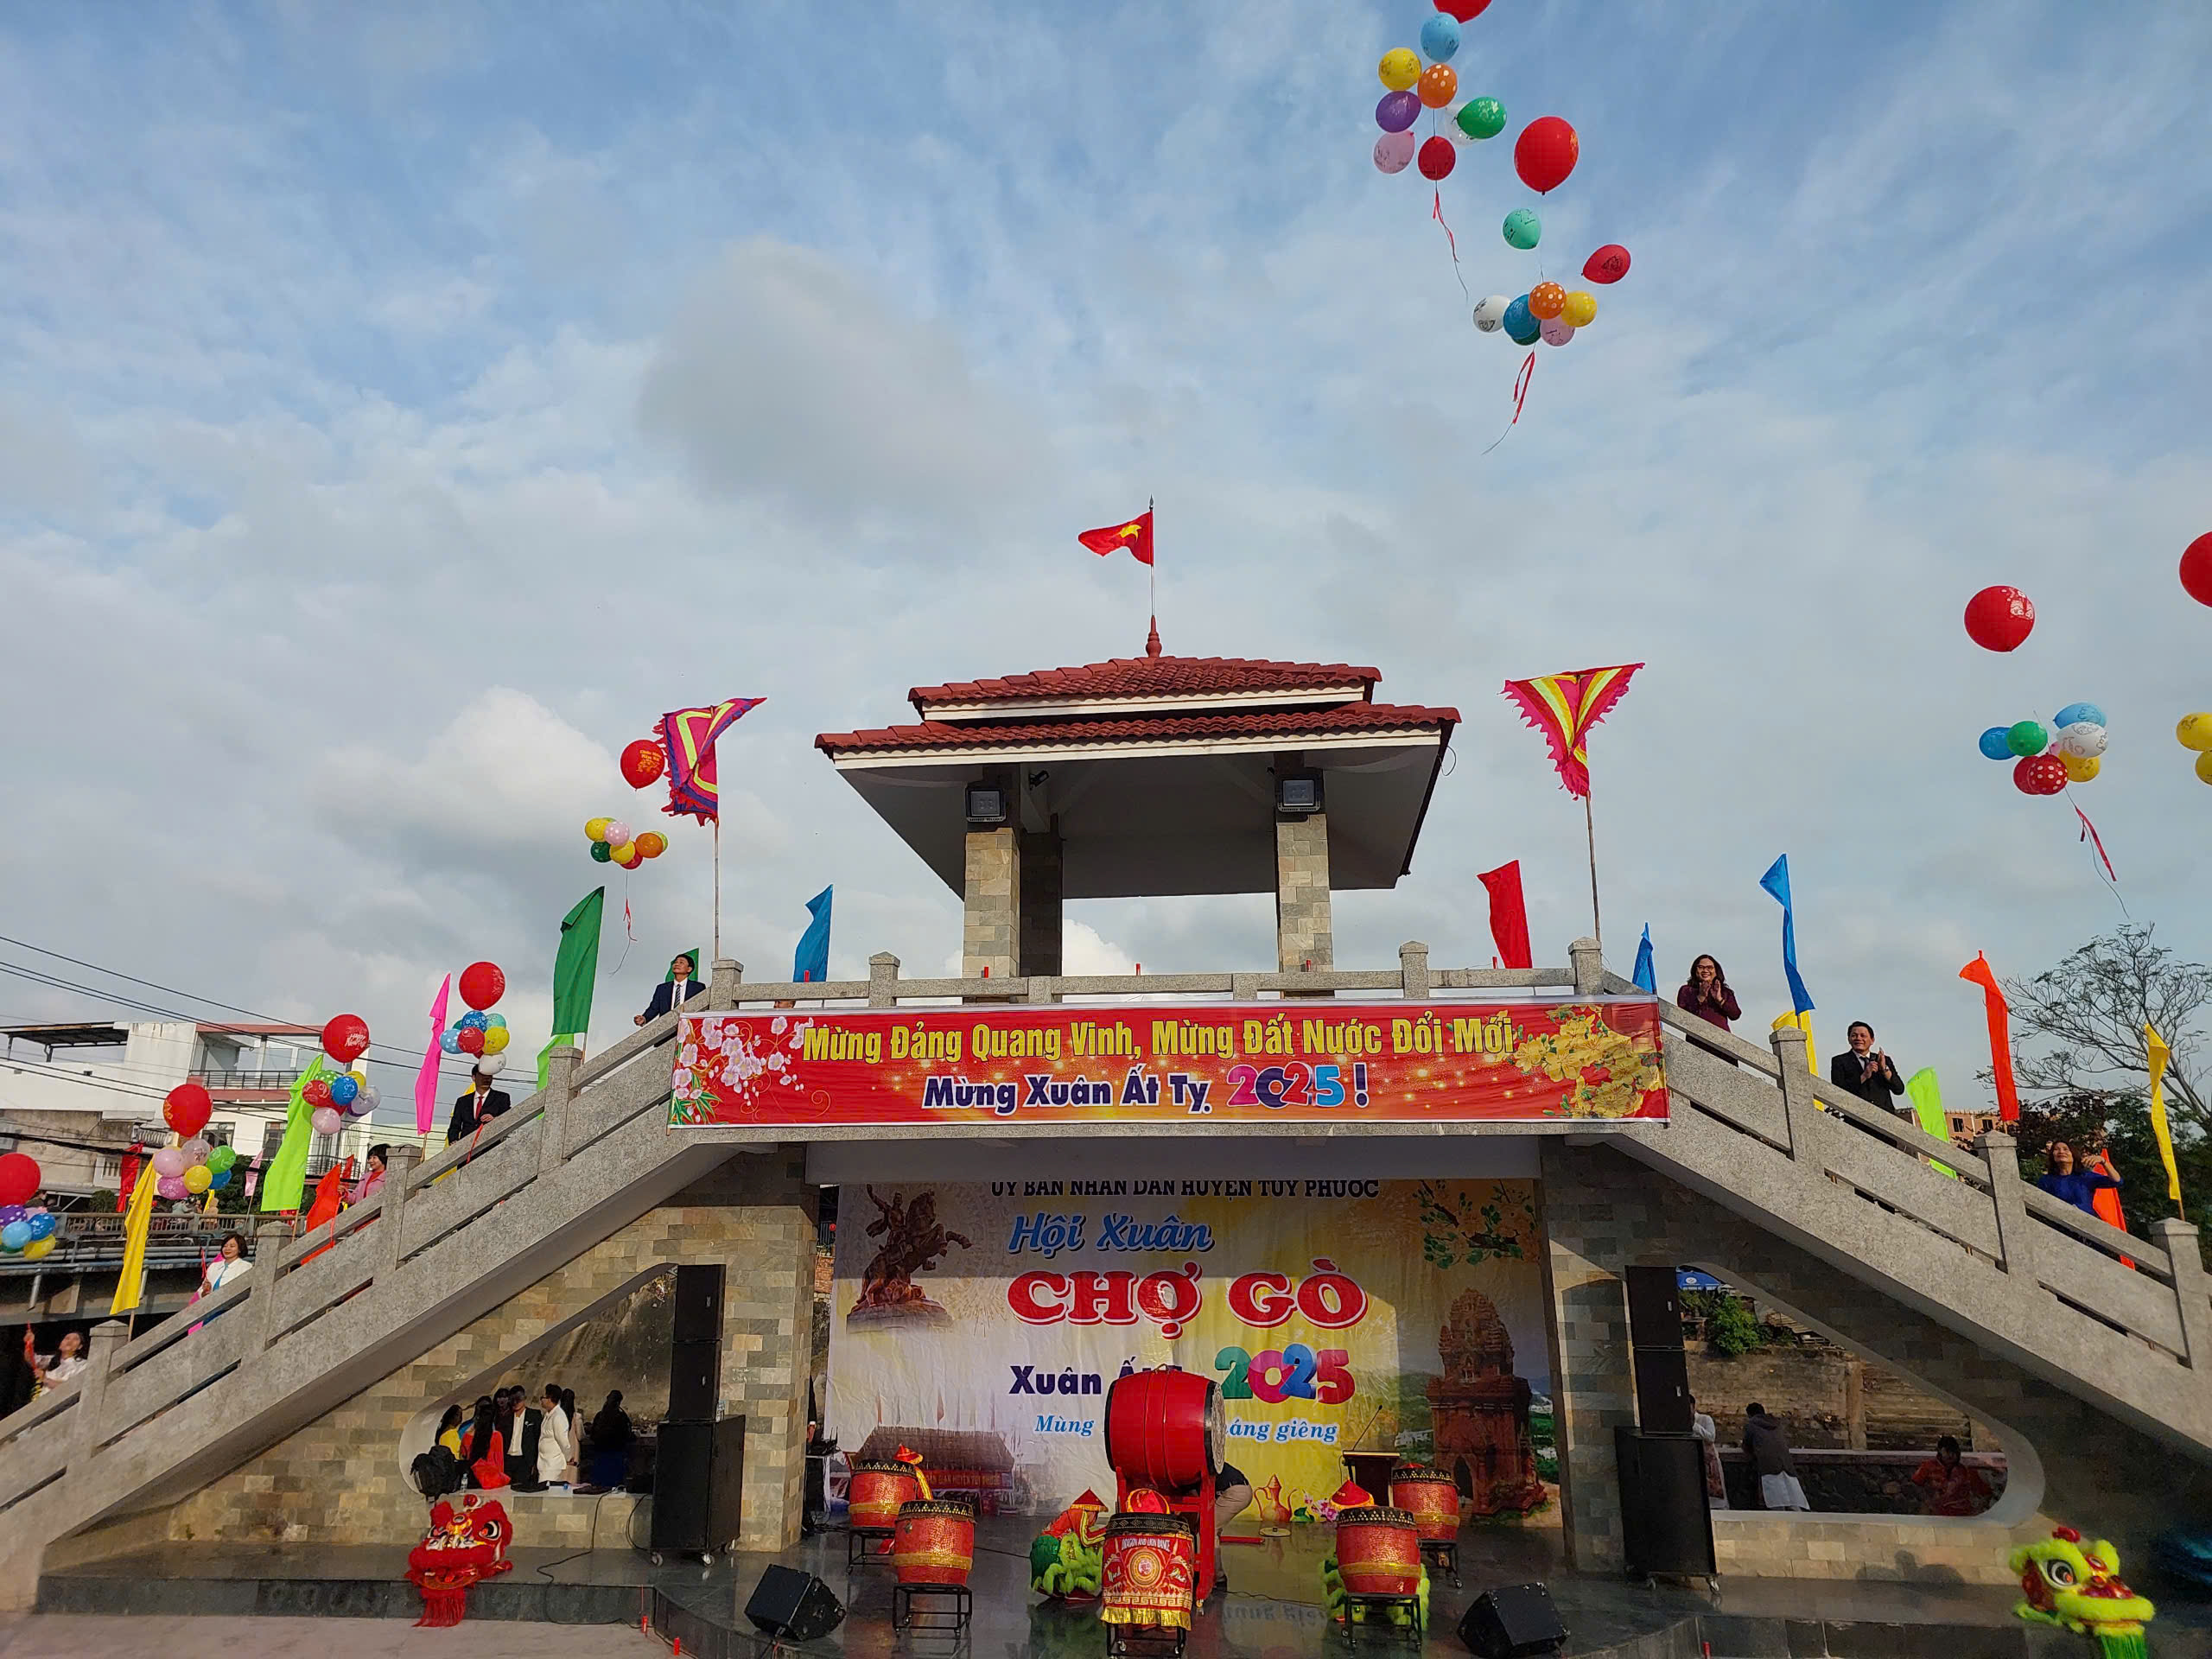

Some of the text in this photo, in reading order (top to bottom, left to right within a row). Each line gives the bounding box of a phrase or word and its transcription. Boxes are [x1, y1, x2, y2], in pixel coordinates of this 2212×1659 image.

[803, 1008, 1516, 1064] Mừng Đảng Quang Vinh, Mừng Đất Nước Đổi Mới
[922, 1075, 1018, 1116] Mừng
[1023, 1072, 1111, 1108] Xuân
[1119, 1064, 1161, 1106] Ất
[1226, 1061, 1345, 1109] 2025
[1353, 1062, 1370, 1109] !
[1257, 1179, 1300, 1198] TUY
[1008, 1212, 1215, 1257] Hội Xuân
[1007, 1258, 1370, 1340] CHỢ GÒ
[1008, 1365, 1102, 1395] Xuân
[1214, 1343, 1356, 1406] 2025
[1034, 1414, 1338, 1443] Mùng áng giêng
